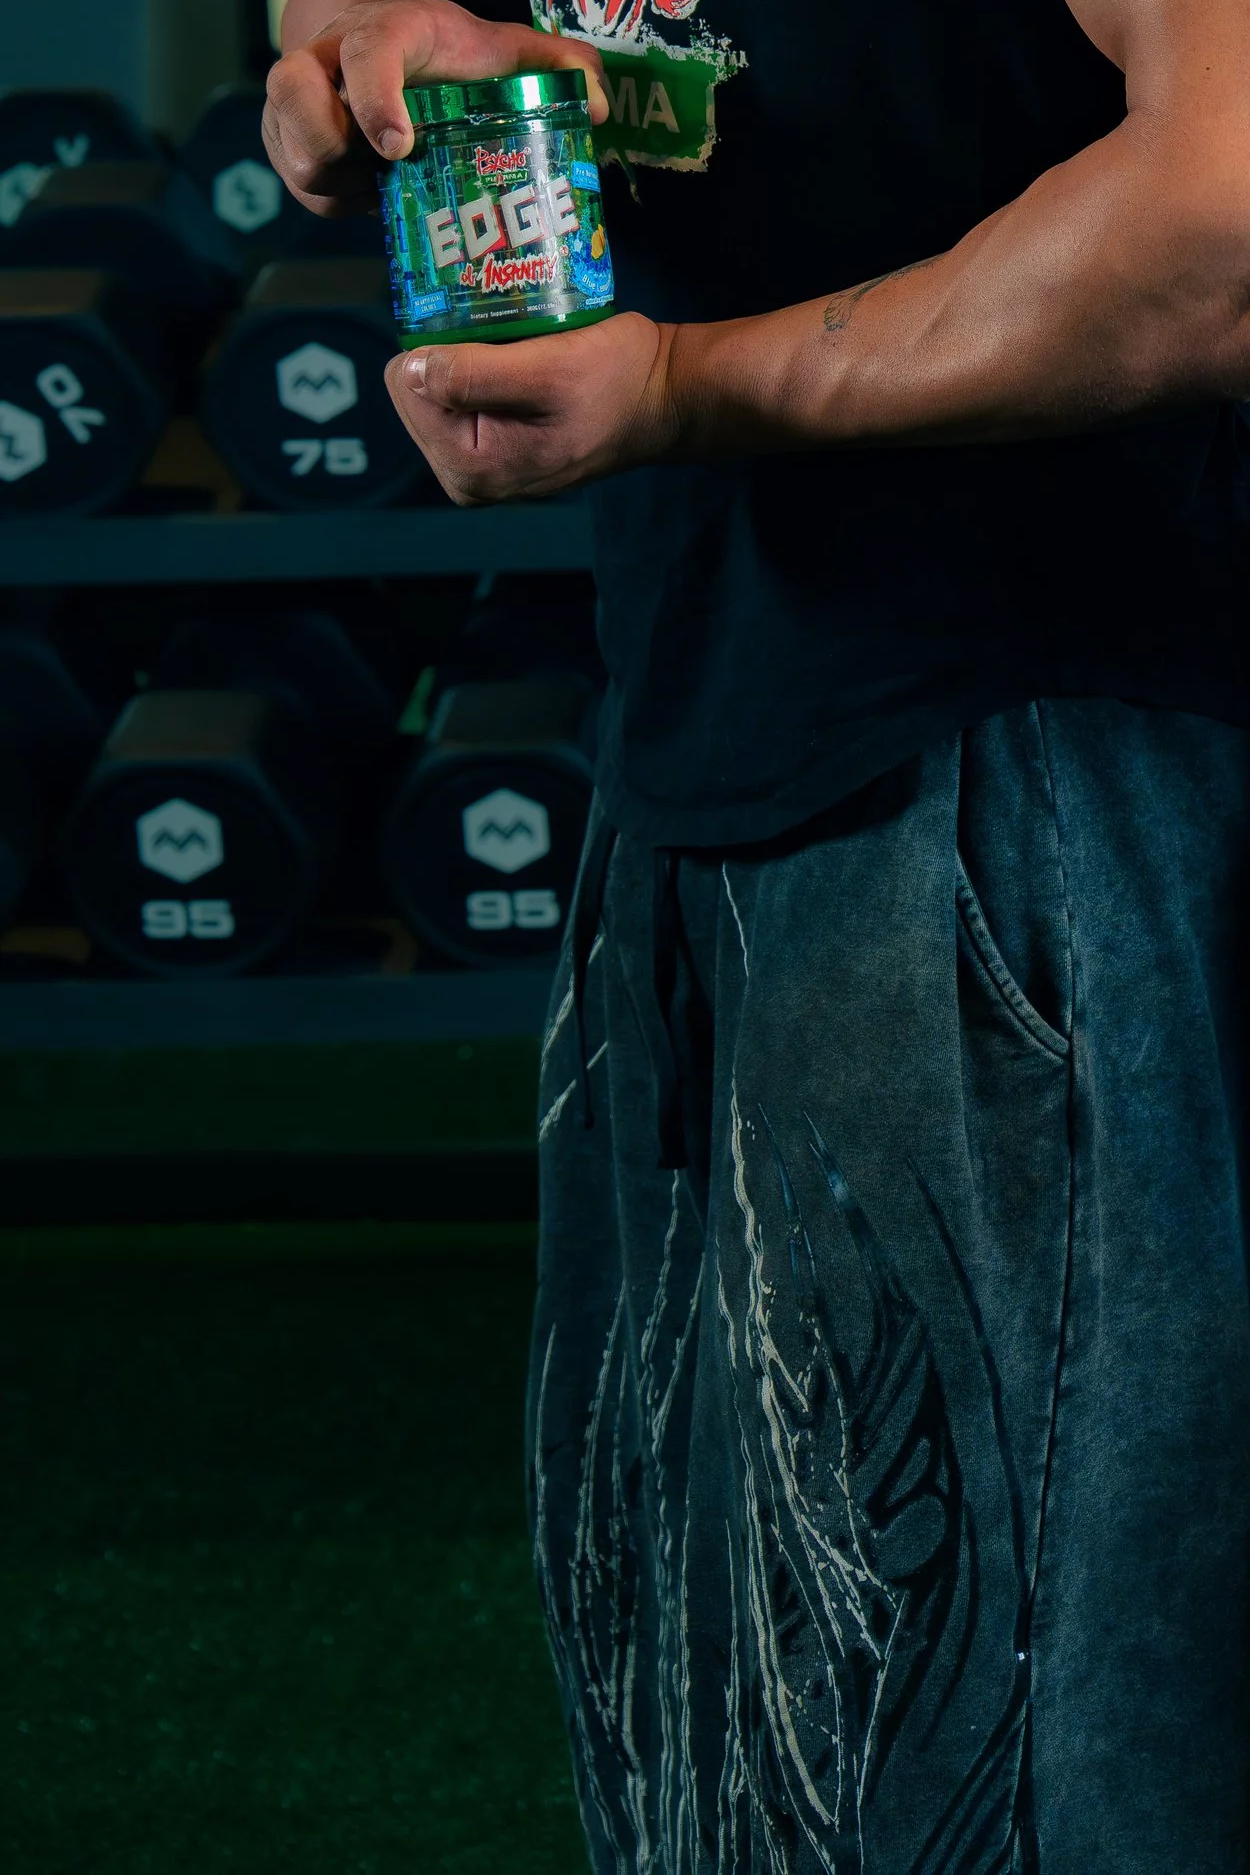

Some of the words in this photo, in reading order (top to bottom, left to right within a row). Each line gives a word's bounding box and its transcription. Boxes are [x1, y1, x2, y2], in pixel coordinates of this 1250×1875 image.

[473, 146, 526, 175] PSYCHO
[425, 175, 580, 268] EDGE
[482, 253, 559, 292] INSANITY
[582, 274, 596, 289] Blue
[490, 308, 519, 317] Supplement
[281, 438, 368, 476] 75
[141, 899, 235, 939] 95
[466, 889, 560, 930] 95
